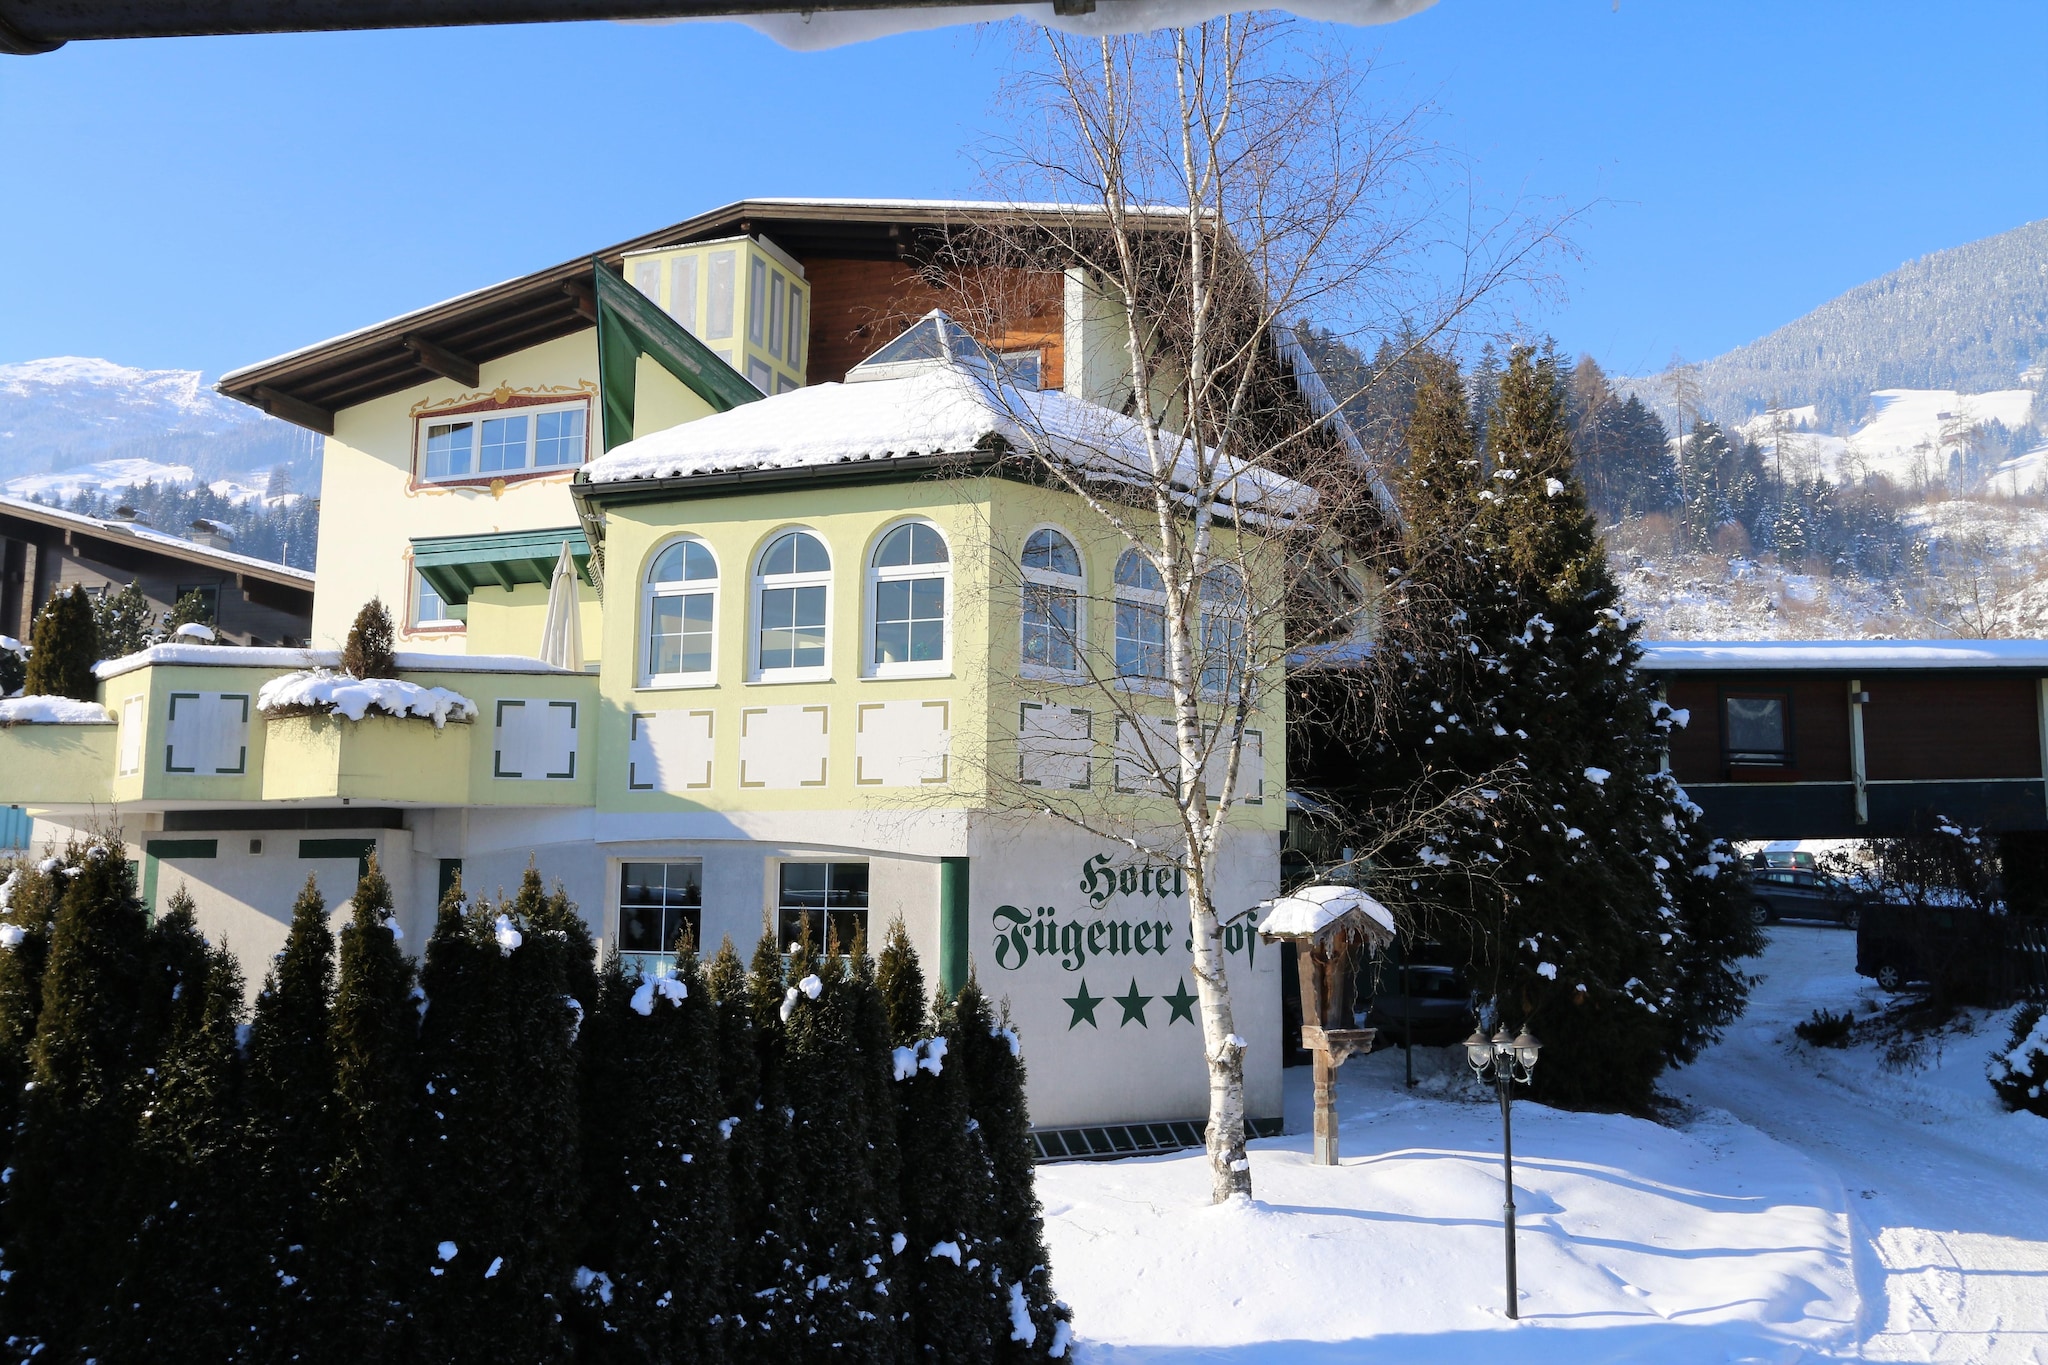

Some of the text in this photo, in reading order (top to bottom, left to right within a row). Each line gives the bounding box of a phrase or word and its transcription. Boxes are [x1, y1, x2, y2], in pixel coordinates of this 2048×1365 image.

[1080, 853, 1187, 910] Hotel
[993, 905, 1258, 971] Fügener of
